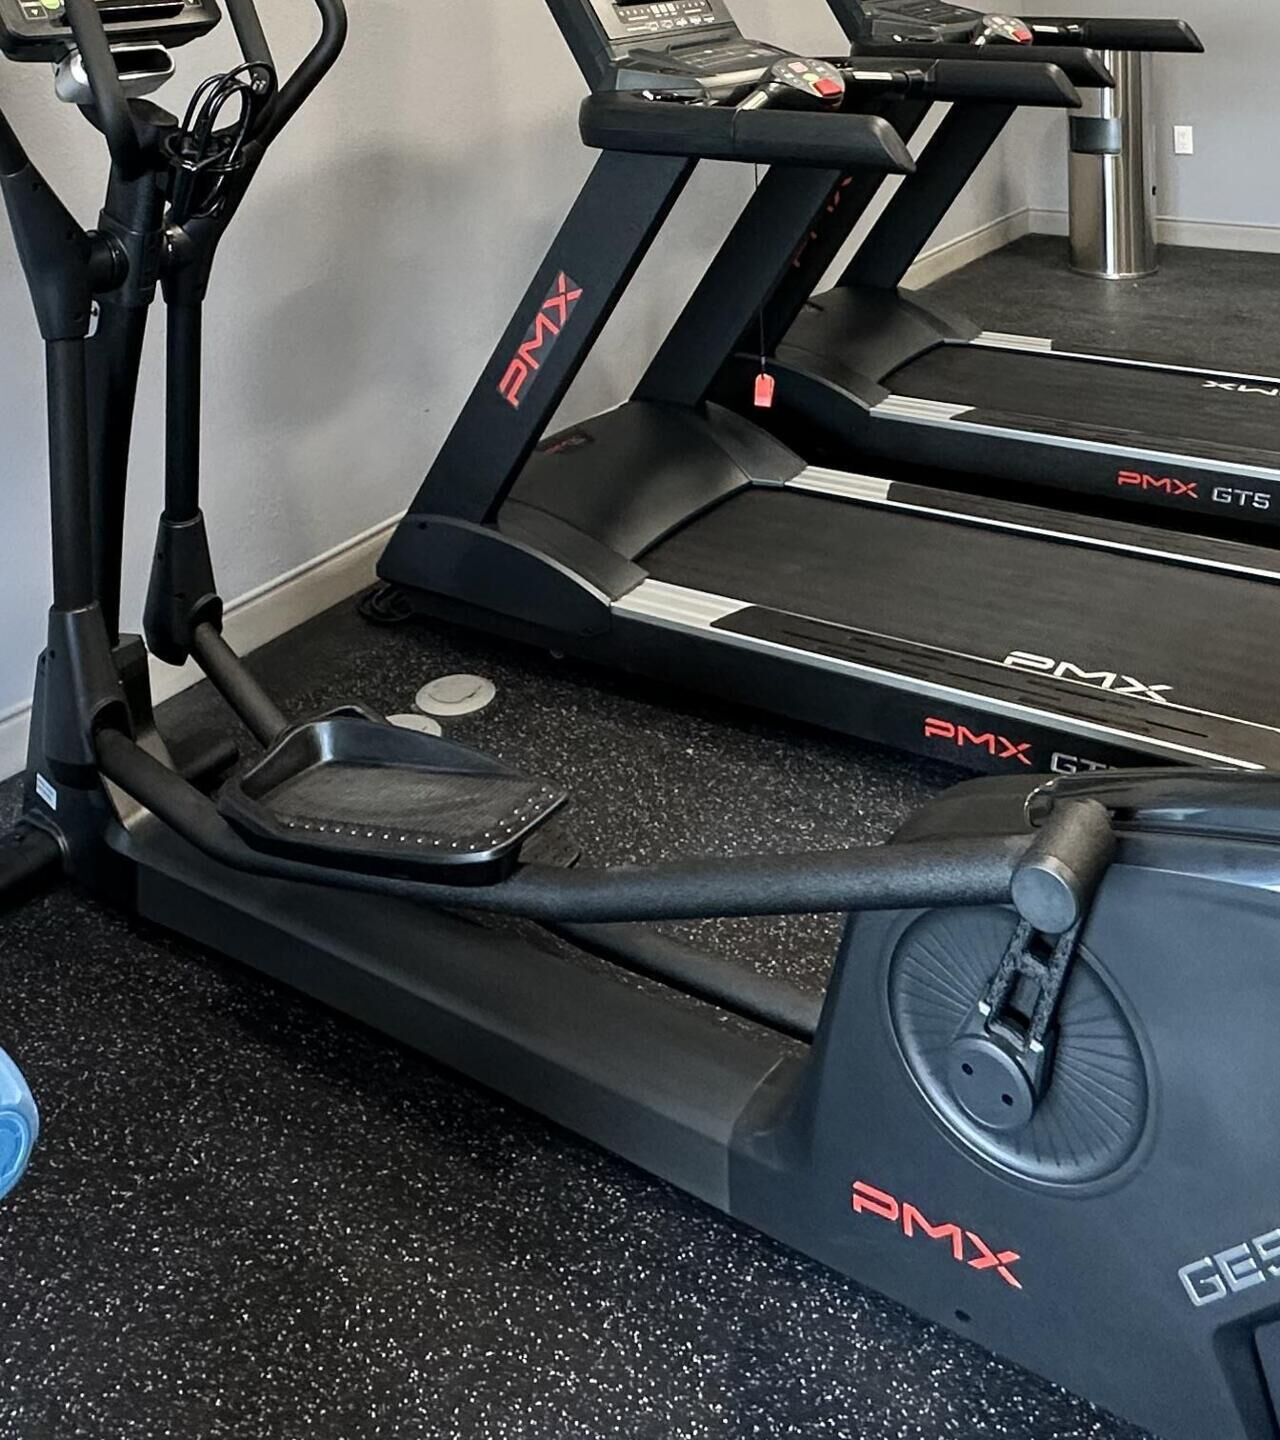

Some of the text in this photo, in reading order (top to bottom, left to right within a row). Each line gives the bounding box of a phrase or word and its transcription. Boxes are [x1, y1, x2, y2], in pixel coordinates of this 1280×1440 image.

[496, 270, 584, 409] PMX
[1117, 471, 1271, 511] PMX GT5
[1003, 650, 1174, 703] PMX
[924, 716, 1118, 774] PMX GT
[851, 1179, 1023, 1290] PMX
